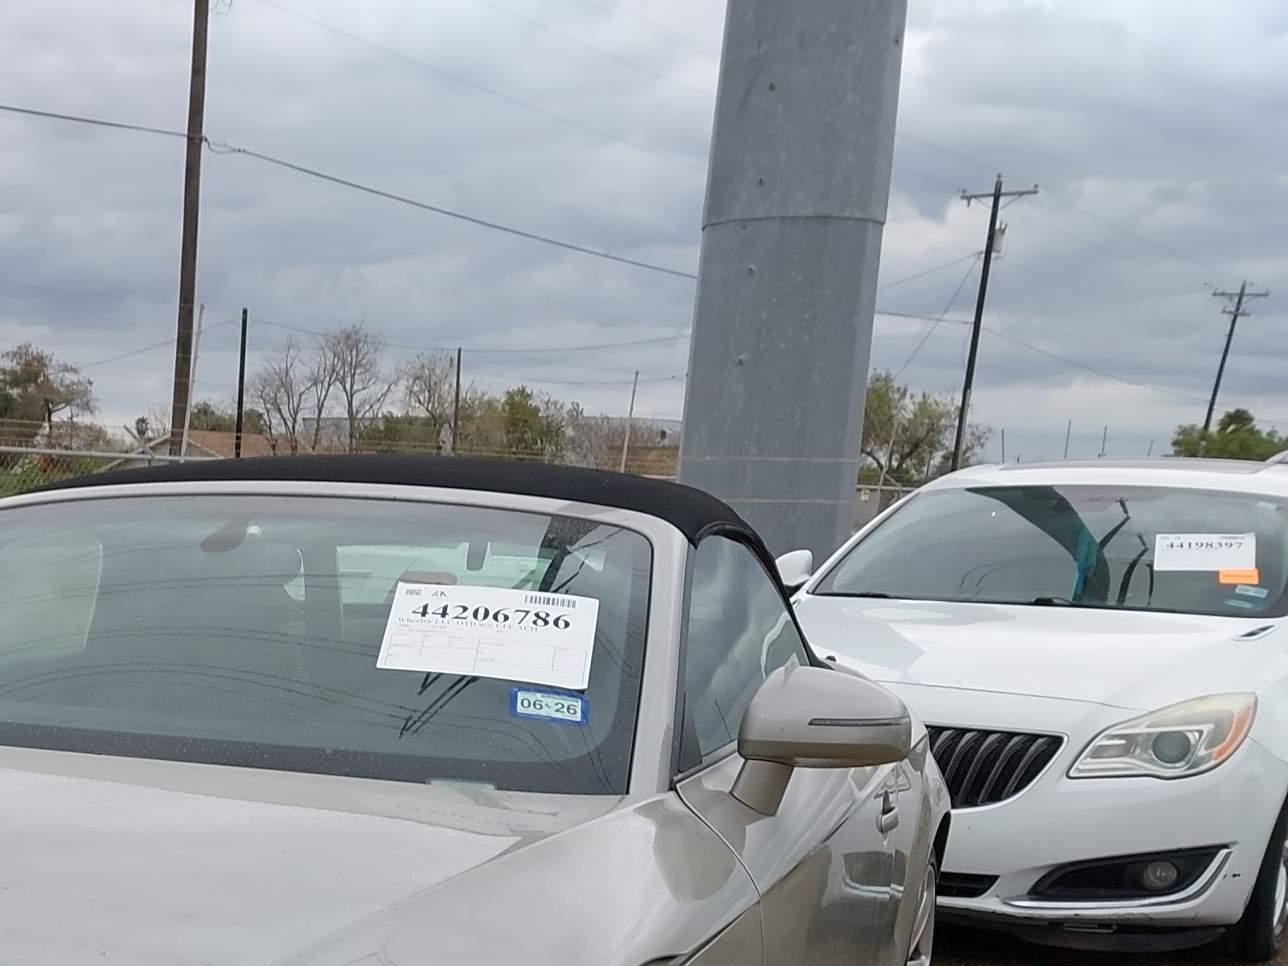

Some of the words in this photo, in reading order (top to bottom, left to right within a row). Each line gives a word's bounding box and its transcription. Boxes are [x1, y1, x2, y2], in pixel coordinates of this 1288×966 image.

[412, 602, 571, 630] 44206786
[520, 697, 544, 711] 06
[554, 701, 578, 716] 26
